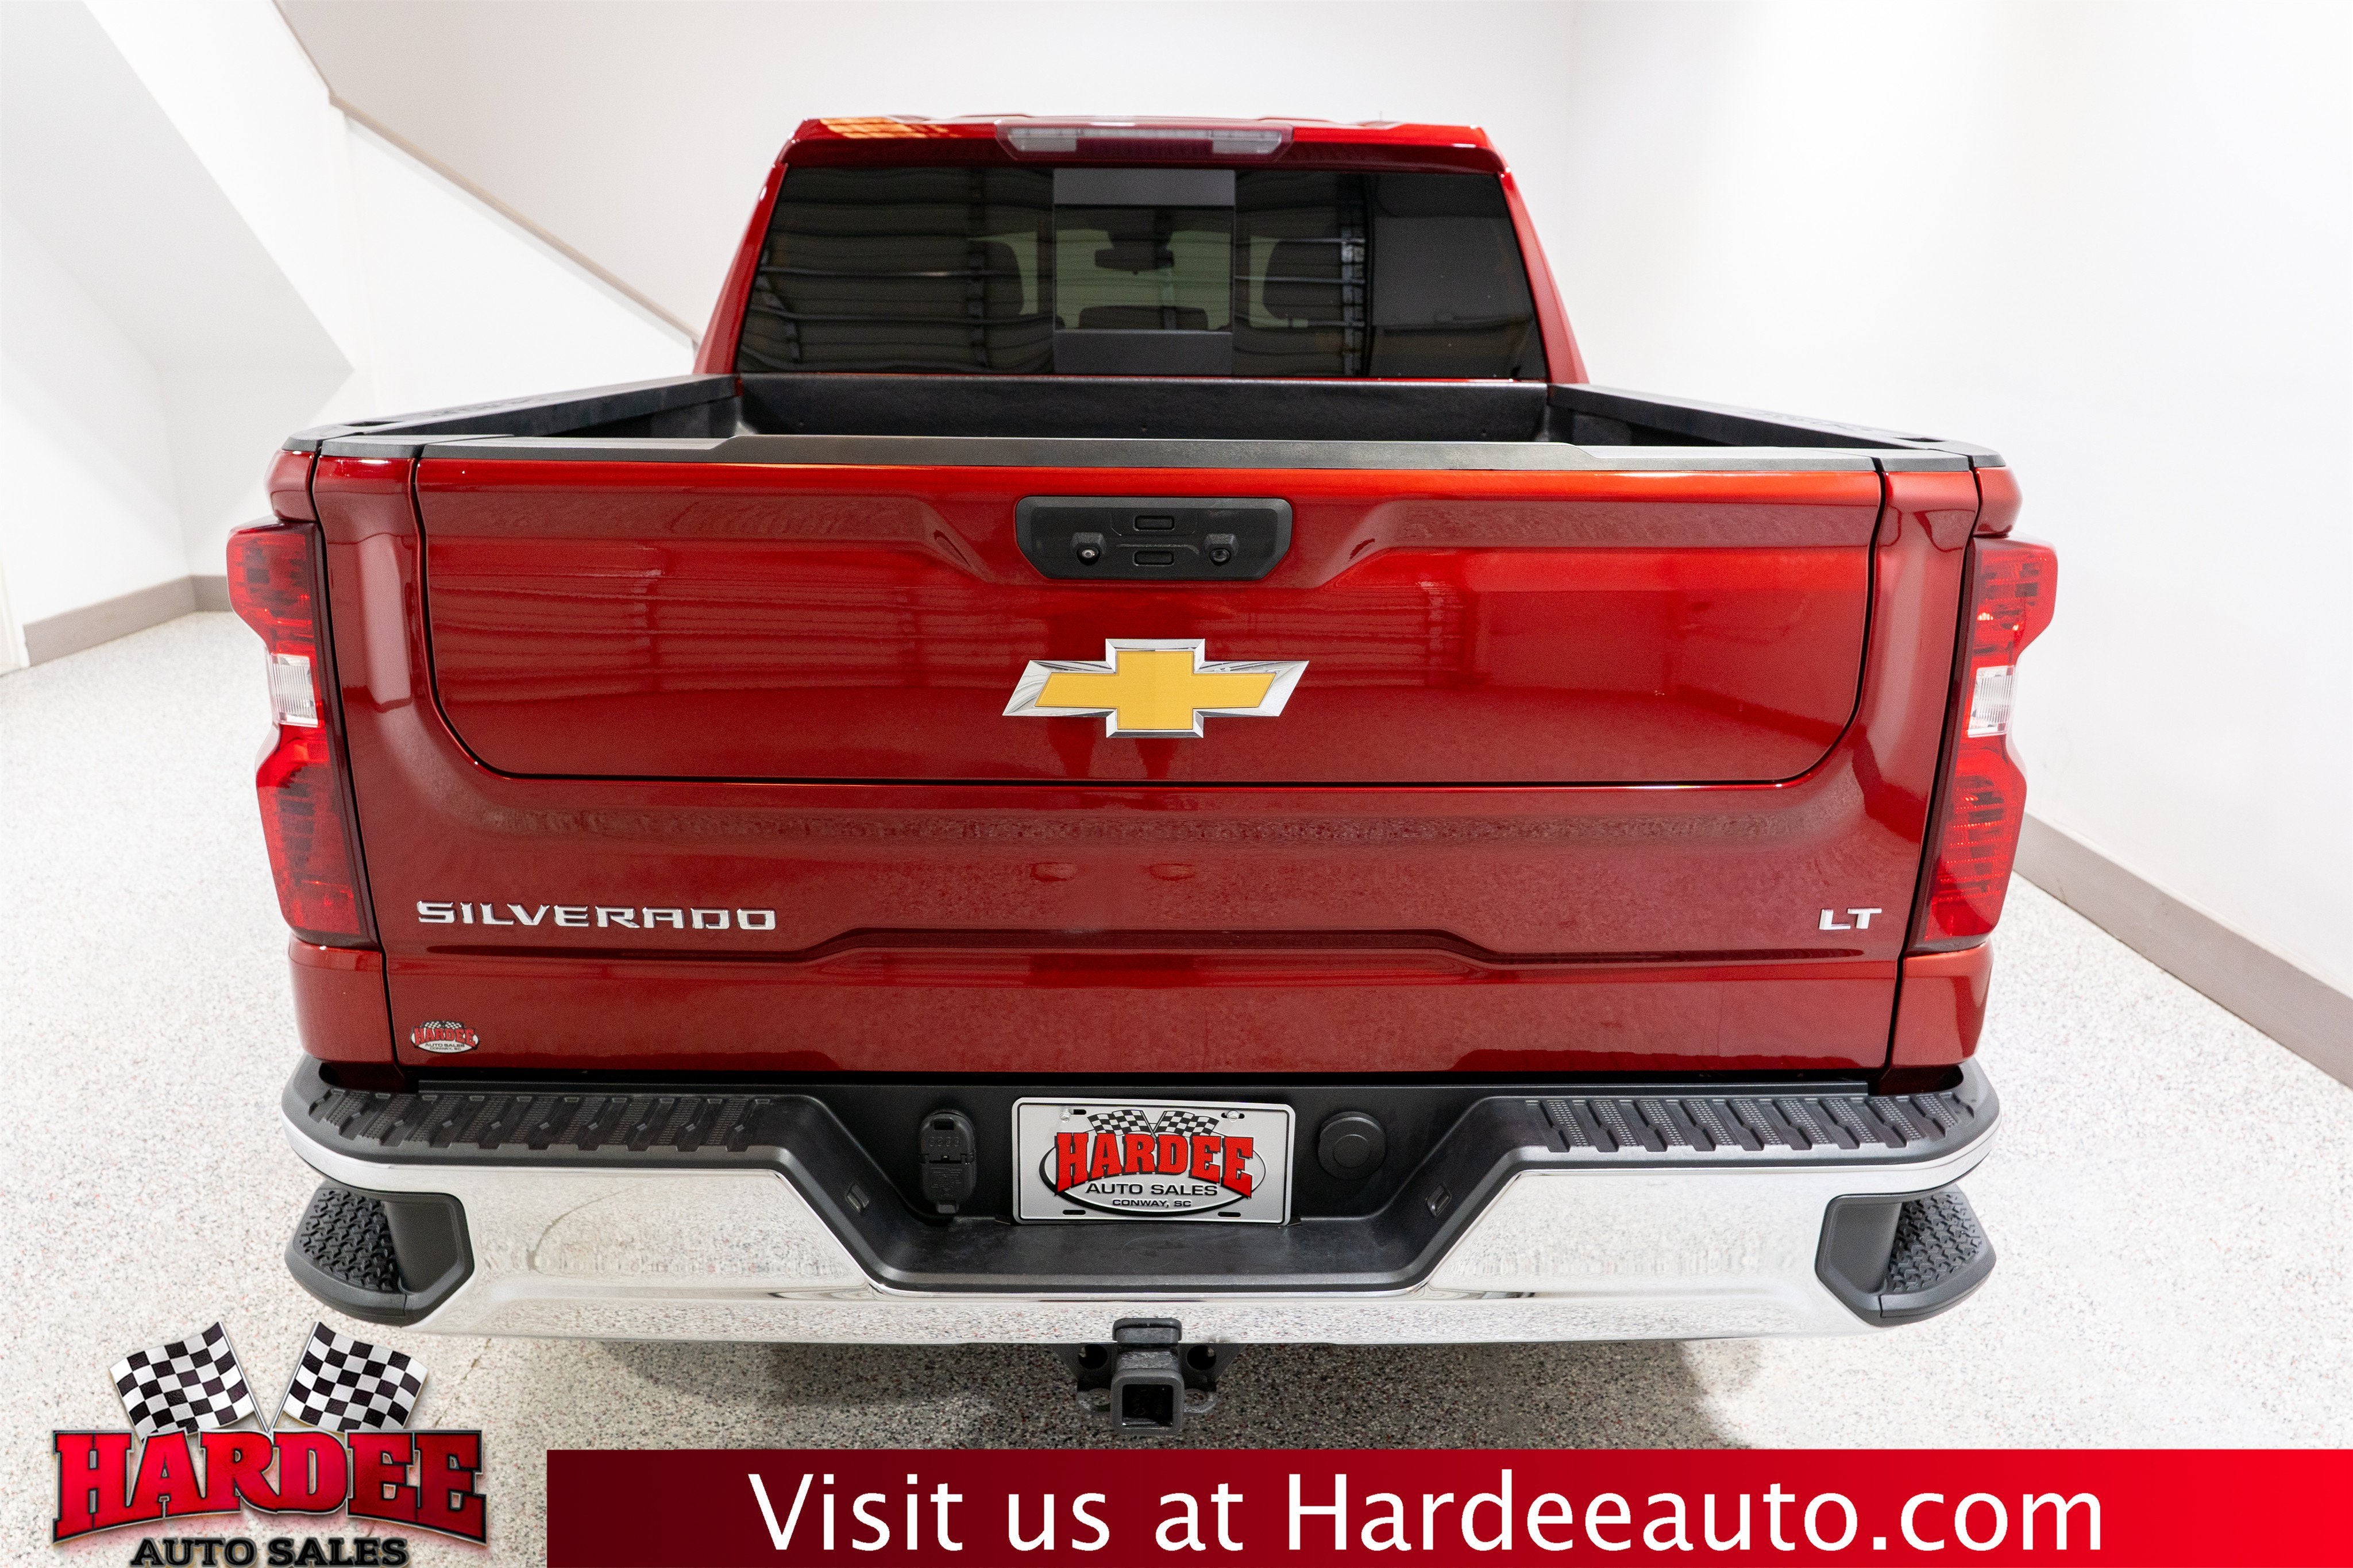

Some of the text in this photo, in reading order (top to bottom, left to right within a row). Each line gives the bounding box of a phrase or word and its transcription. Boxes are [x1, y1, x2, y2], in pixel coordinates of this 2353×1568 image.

[416, 901, 776, 930] SILVERADO
[1819, 907, 1882, 930] LT
[414, 1027, 476, 1047] HARDEE
[1054, 1132, 1254, 1199] HARDEE
[1085, 1183, 1218, 1196] AUTO SALES
[1112, 1199, 1170, 1208] CONWAY,
